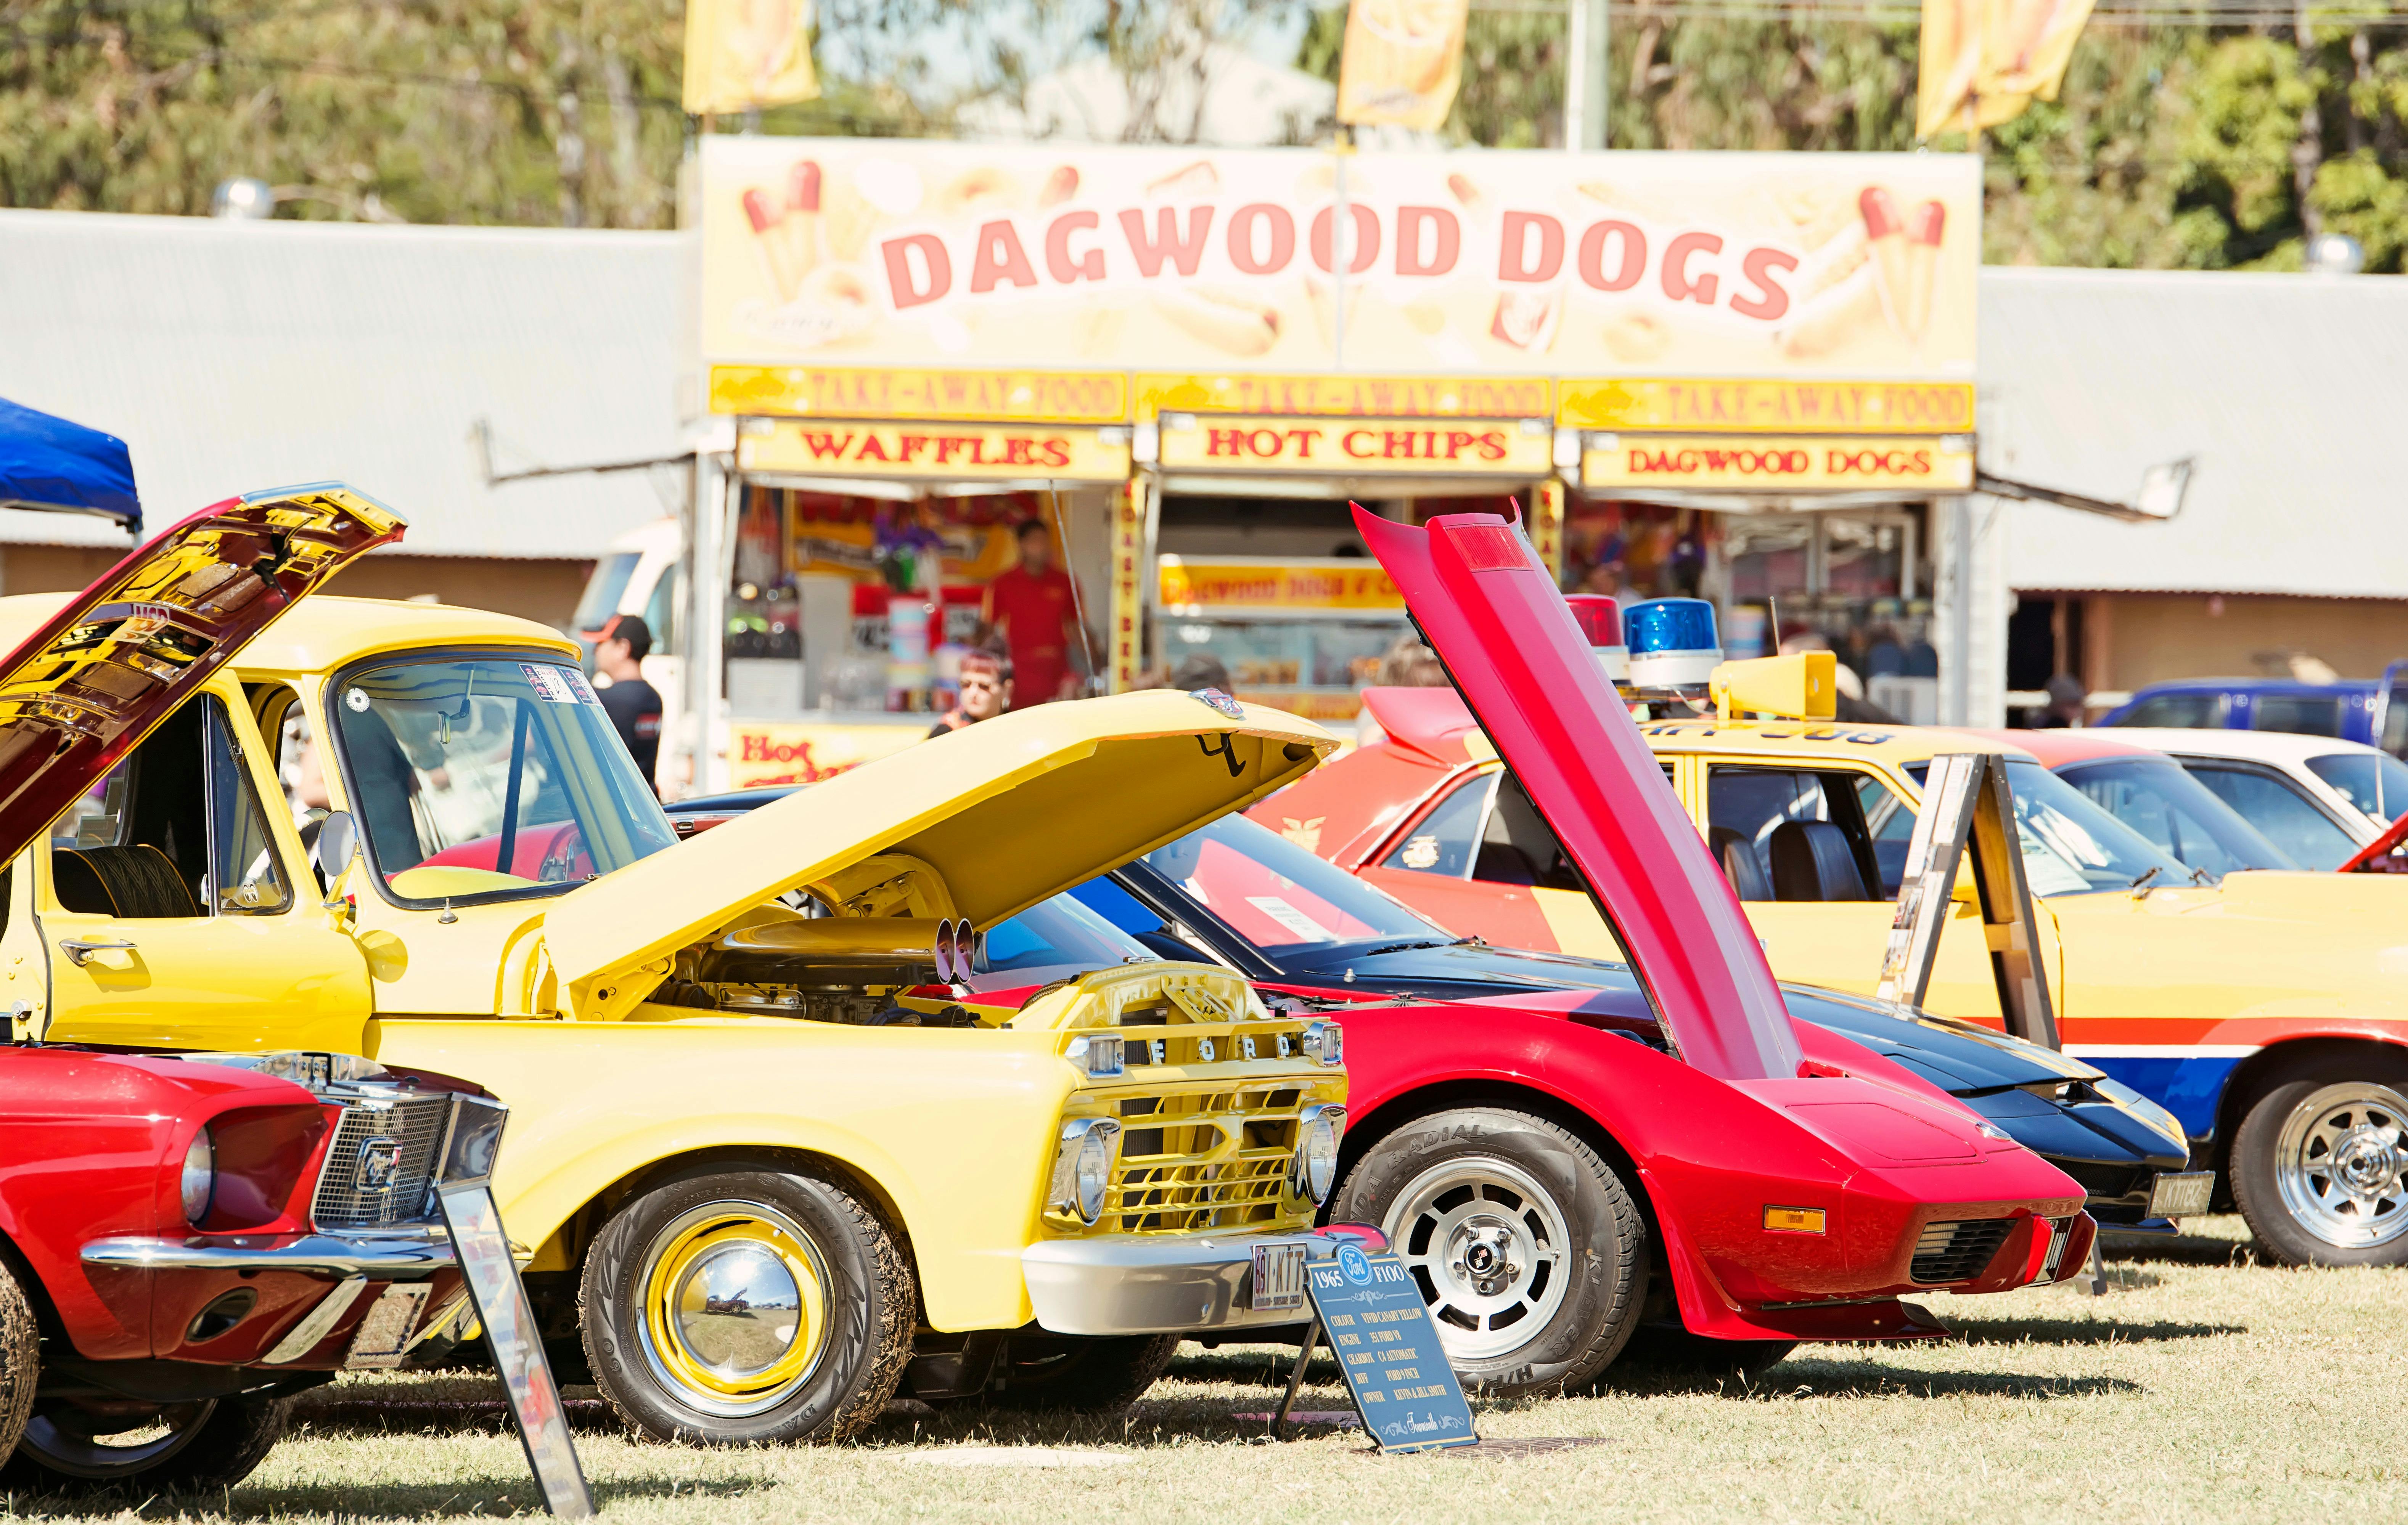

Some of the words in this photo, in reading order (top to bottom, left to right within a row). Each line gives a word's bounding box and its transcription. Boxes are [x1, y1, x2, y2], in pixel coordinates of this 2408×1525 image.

[881, 202, 1460, 310] DAGWOOD
[1498, 210, 1799, 321] DOGS
[1035, 377, 1116, 413] FOOD
[1460, 384, 1541, 417] FOOD
[1884, 387, 1966, 423] FOOD
[802, 434, 1070, 467] WAFFLES
[1207, 429, 1323, 458] HOT
[1342, 430, 1507, 460] CHIPS
[1629, 449, 1808, 474] DAGWOOD
[1827, 449, 1930, 475] DOGS
[1121, 617, 1132, 681] BEE
[741, 735, 812, 765] Hot
[1149, 1035, 1291, 1064] FORD
[1387, 1124, 1486, 1170] RADIAL
[1315, 1270, 1344, 1288] 1965
[1344, 1252, 1365, 1276] Ford
[1373, 1265, 1405, 1283] F100
[1330, 1314, 1356, 1327] COLOUR
[1361, 1312, 1378, 1324] VIVID
[1378, 1310, 1400, 1322] CANARY
[1399, 1308, 1423, 1320] YELLOW
[1550, 1253, 1603, 1356] KLEVER
[1337, 1333, 1362, 1346] ENGINE
[1369, 1332, 1379, 1343] 351
[1377, 1330, 1394, 1342] FORD
[1392, 1329, 1402, 1341] V8
[1347, 1352, 1375, 1365] GEARBOX
[1377, 1351, 1387, 1362] C4
[1386, 1348, 1419, 1362] AUTOMATIC
[1354, 1372, 1369, 1385] DIFF
[1385, 1369, 1402, 1381] FORD
[1400, 1369, 1405, 1380] 9
[1404, 1367, 1420, 1379] INCH
[1486, 1363, 1534, 1391] H/P
[1363, 1391, 1386, 1404] OWNER
[1393, 1388, 1413, 1401] KEVIN
[1411, 1387, 1418, 1398] &
[1415, 1386, 1430, 1398] JILL
[1427, 1384, 1447, 1397] SMITH
